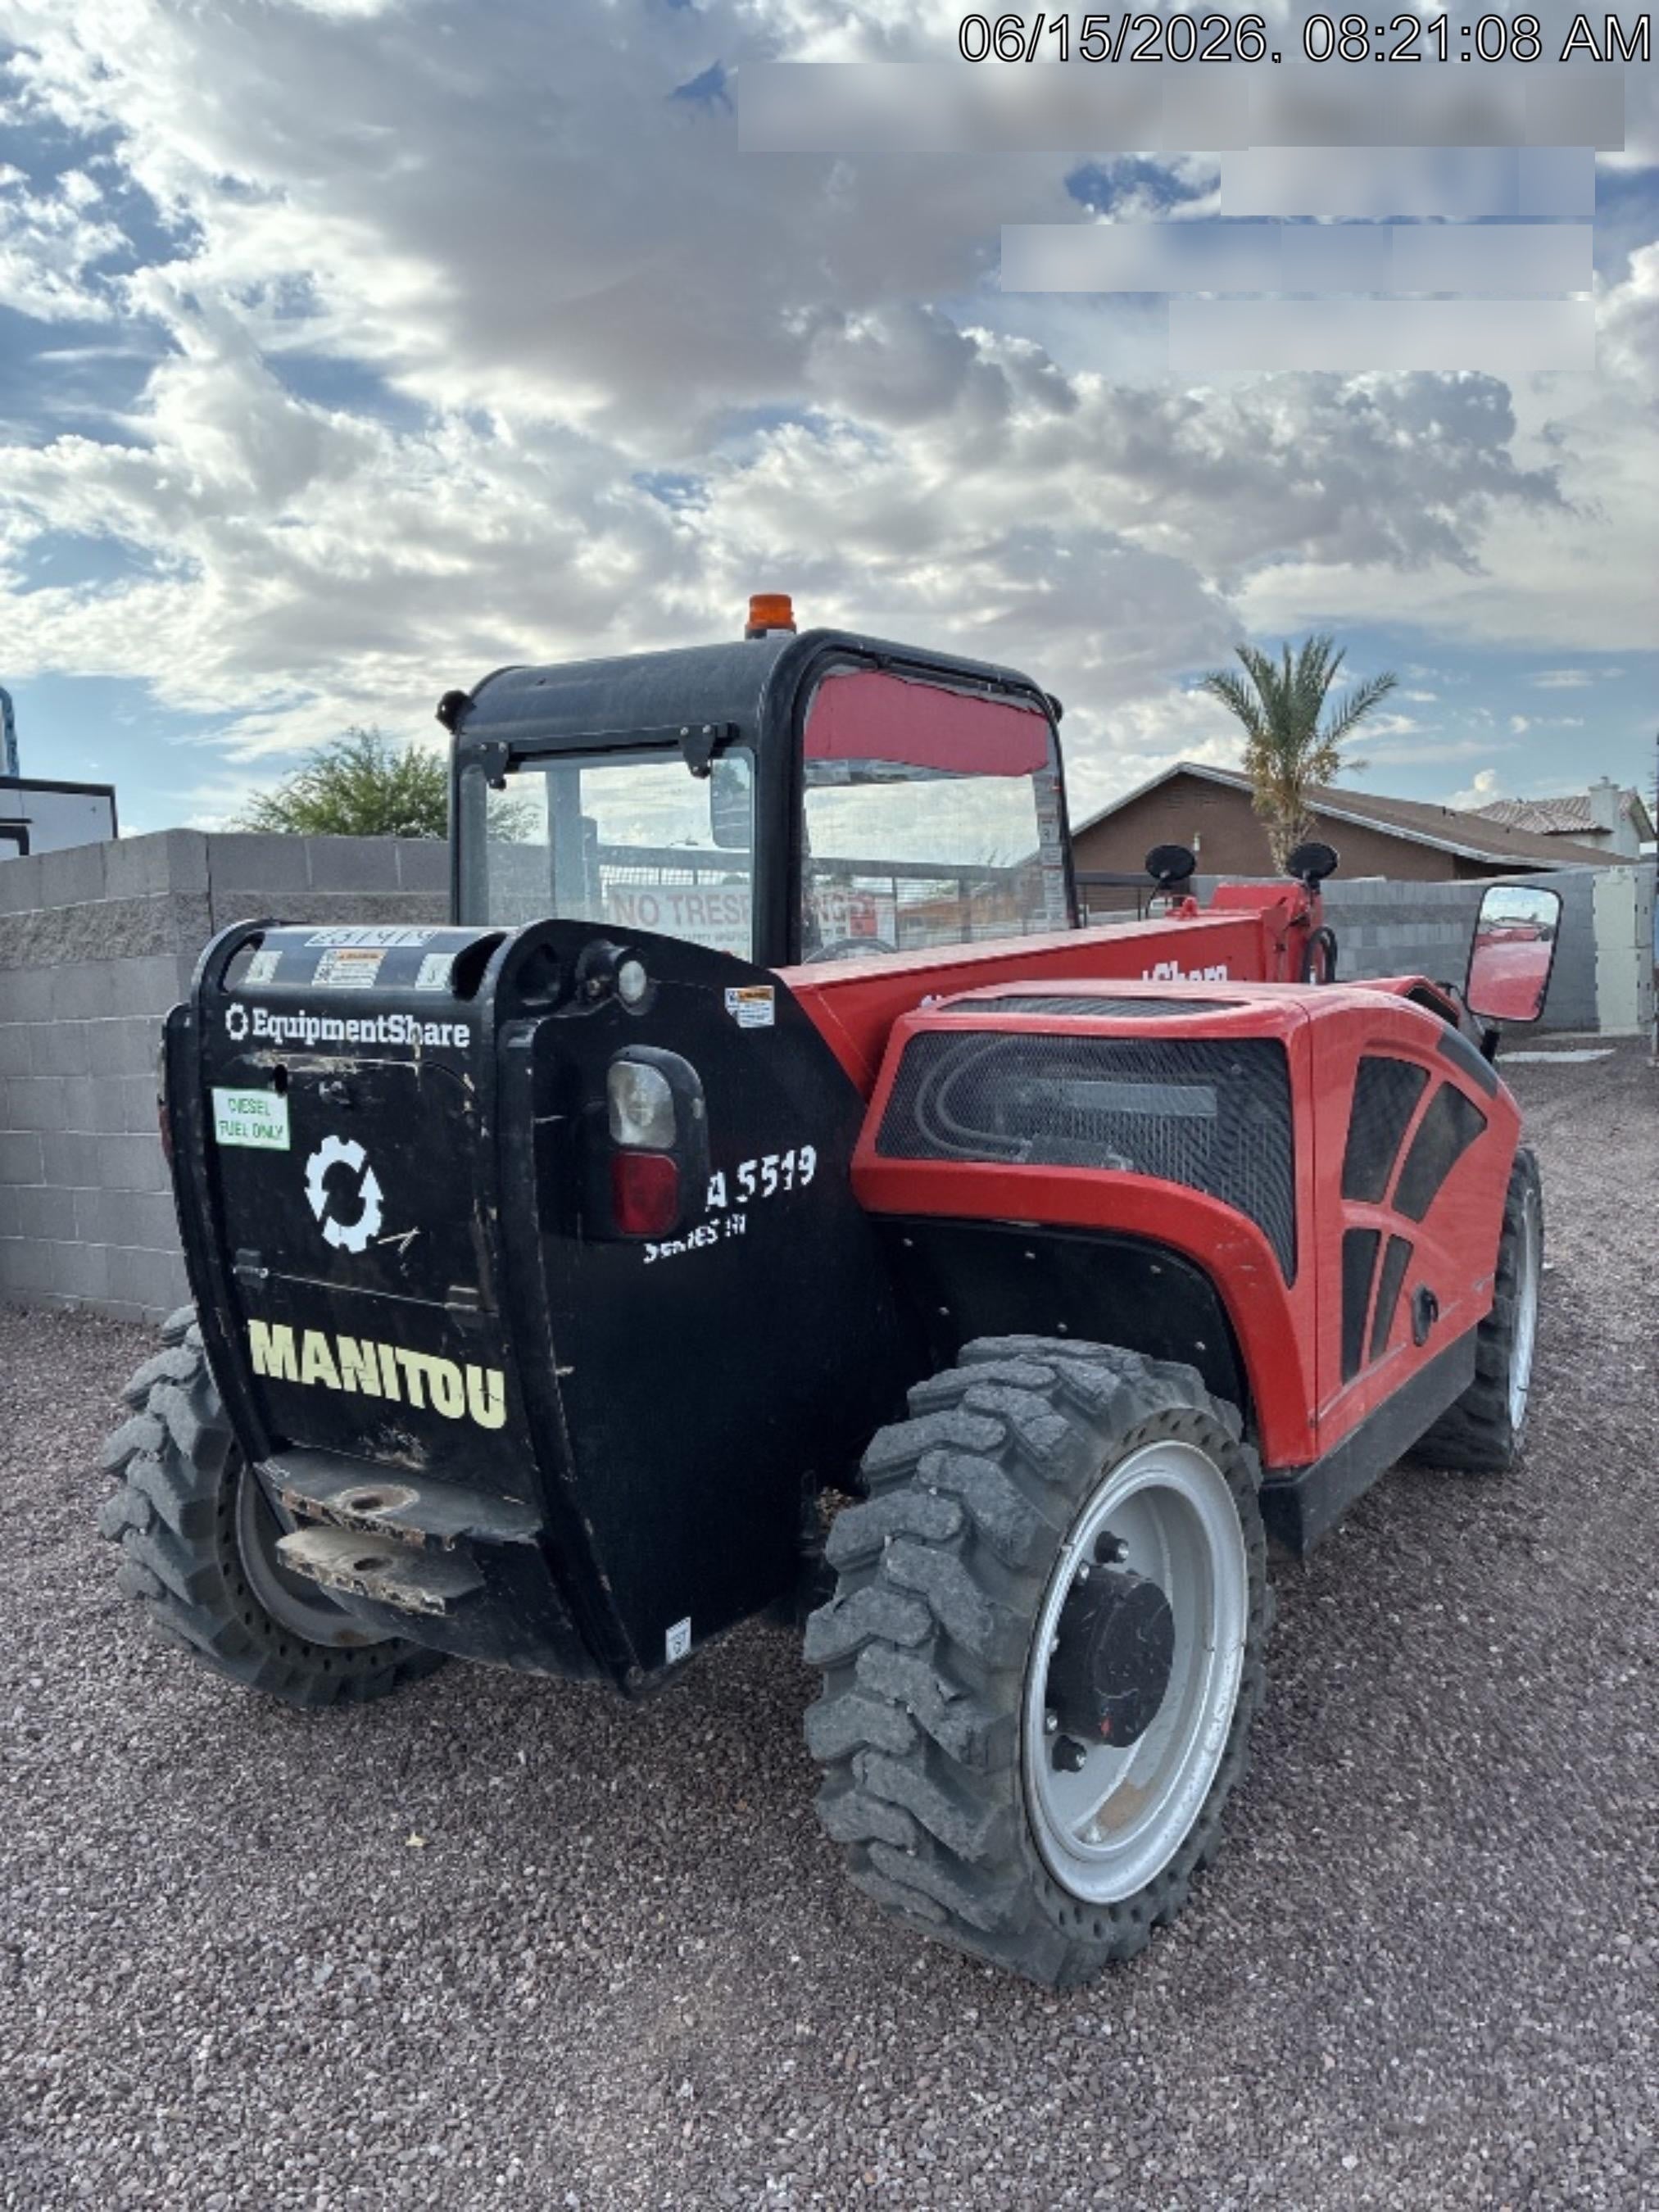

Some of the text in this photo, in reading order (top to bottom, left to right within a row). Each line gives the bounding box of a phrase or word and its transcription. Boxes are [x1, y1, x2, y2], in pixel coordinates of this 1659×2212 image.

[613, 894, 660, 927] NO
[252, 1007, 470, 1048] EquipmentShare
[228, 1098, 271, 1117] DIESEL
[218, 1120, 283, 1140] FUEL ONLY
[735, 1145, 817, 1203] 5519
[247, 1318, 507, 1429] MANITOU
